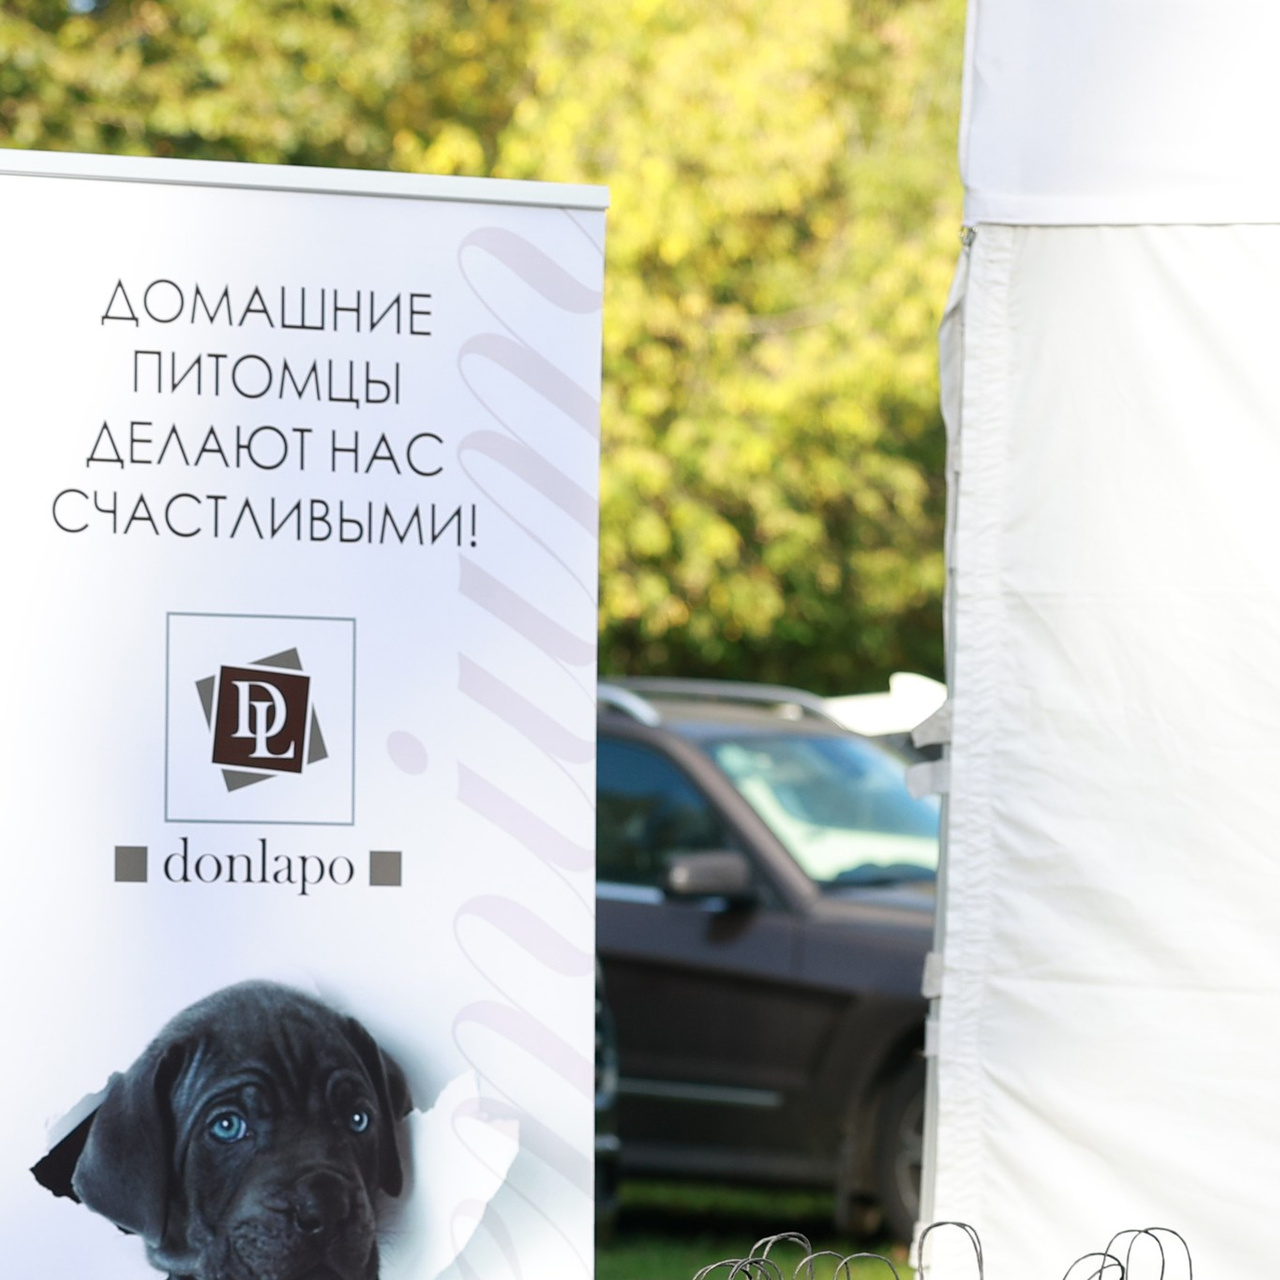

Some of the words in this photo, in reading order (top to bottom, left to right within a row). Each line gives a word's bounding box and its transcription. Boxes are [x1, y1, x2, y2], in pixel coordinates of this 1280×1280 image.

[101, 278, 432, 336] ДОМАШНИЕ
[133, 350, 401, 409] ПИТОМЦЫ
[86, 420, 313, 471] ДЕЛАЮТ
[331, 429, 445, 477] НАС
[52, 488, 478, 548] СЧАСТЛИВЫМИ!
[163, 836, 355, 896] donlapo
